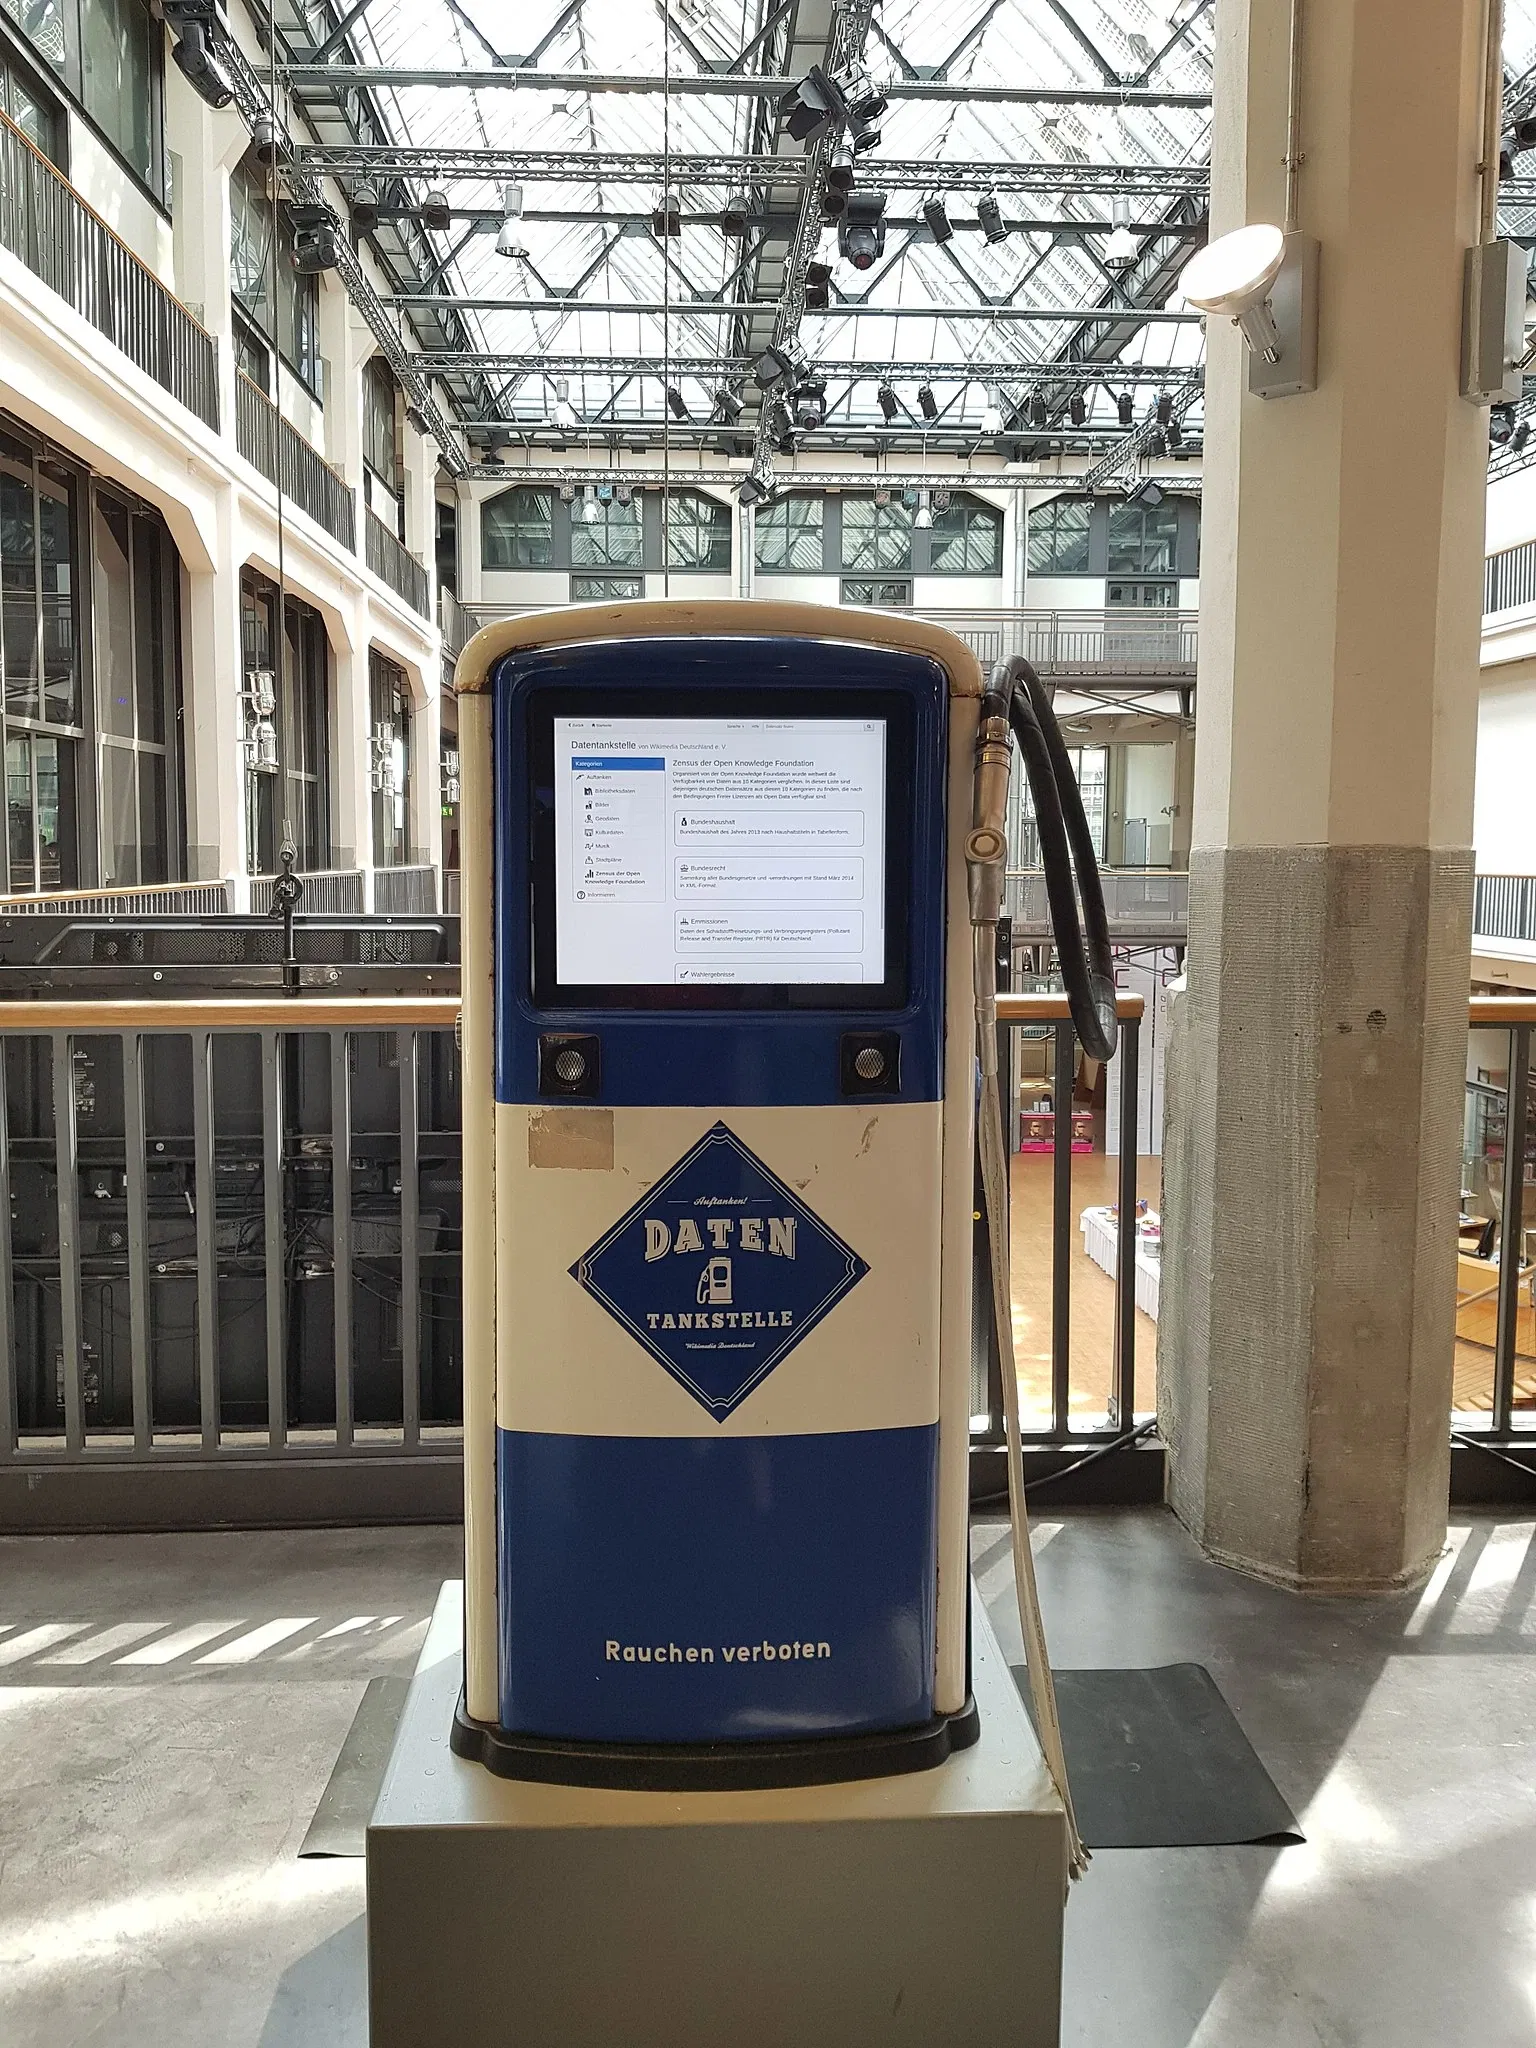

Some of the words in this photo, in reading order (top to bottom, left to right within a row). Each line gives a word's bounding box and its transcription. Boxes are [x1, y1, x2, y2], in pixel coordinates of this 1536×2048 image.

[571, 740, 636, 750] Datentankstelle
[672, 759, 699, 768] Zensus
[700, 759, 712, 768] der
[713, 759, 733, 768] Open
[734, 759, 774, 768] Knowledge
[775, 759, 814, 768] Foundation
[693, 1196, 748, 1208] Auftanken!
[644, 1217, 797, 1262] DATEN
[647, 1311, 793, 1329] TANKSTELLE
[605, 1640, 715, 1663] Rauchen
[721, 1640, 832, 1662] verboten
